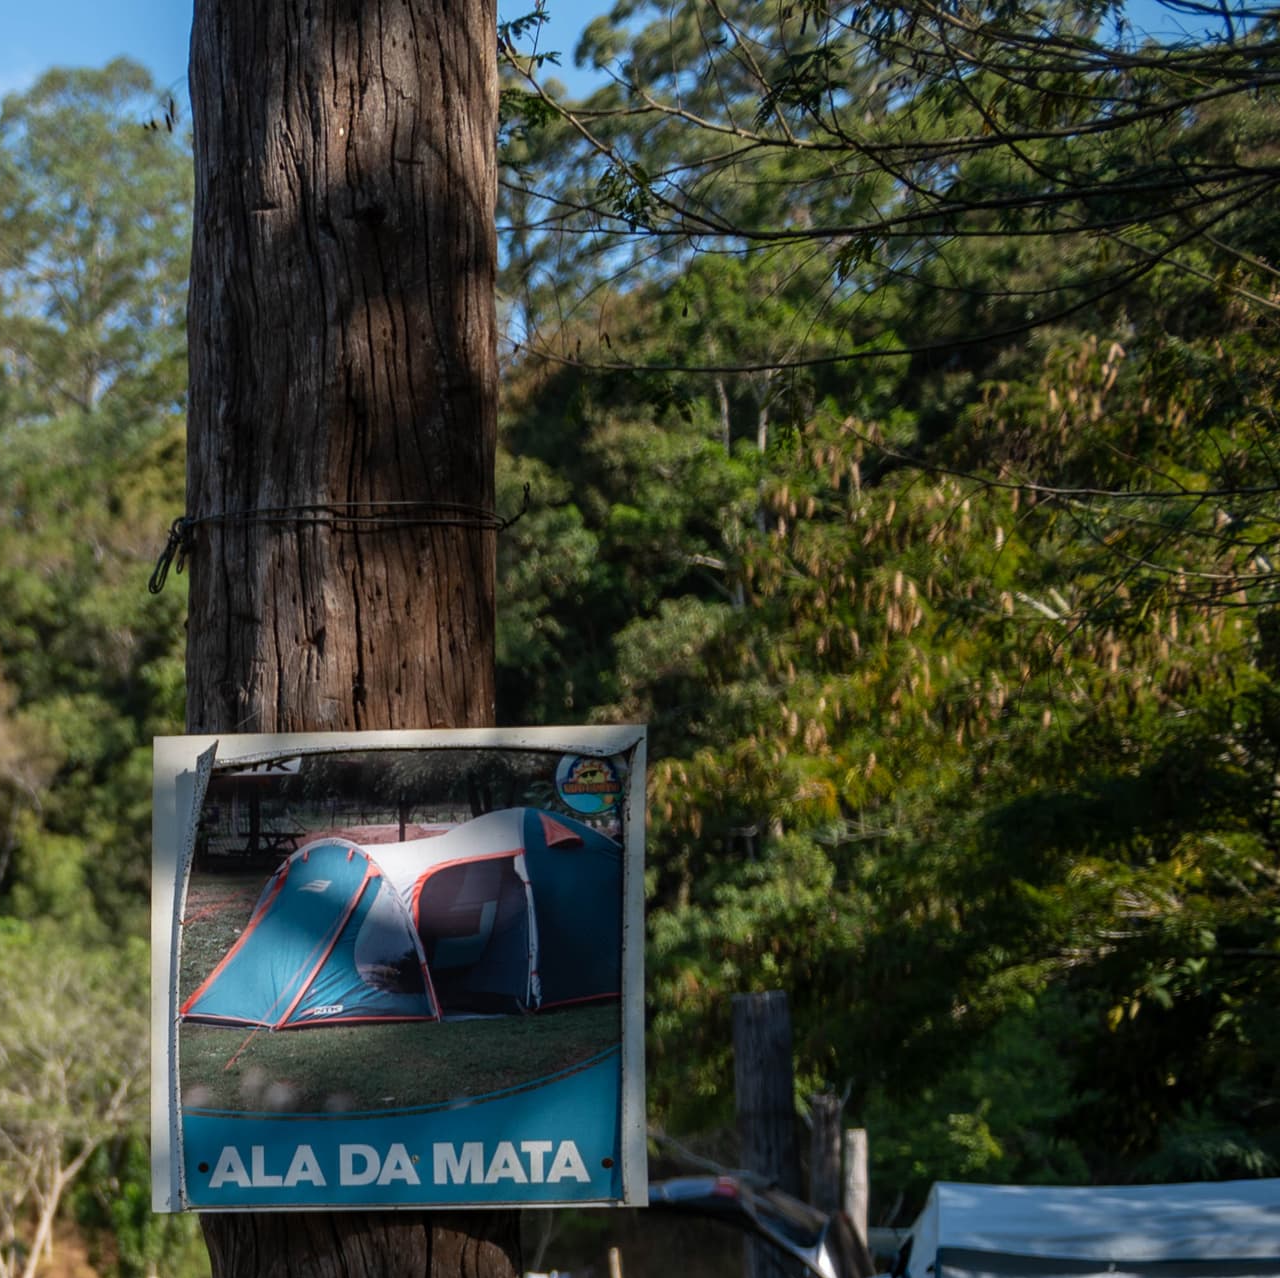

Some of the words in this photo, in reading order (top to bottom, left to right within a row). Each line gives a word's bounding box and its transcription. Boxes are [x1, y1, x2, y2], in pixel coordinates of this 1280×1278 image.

[208, 1144, 327, 1188] ALA
[339, 1143, 421, 1187] DA
[433, 1140, 591, 1185] MATA
